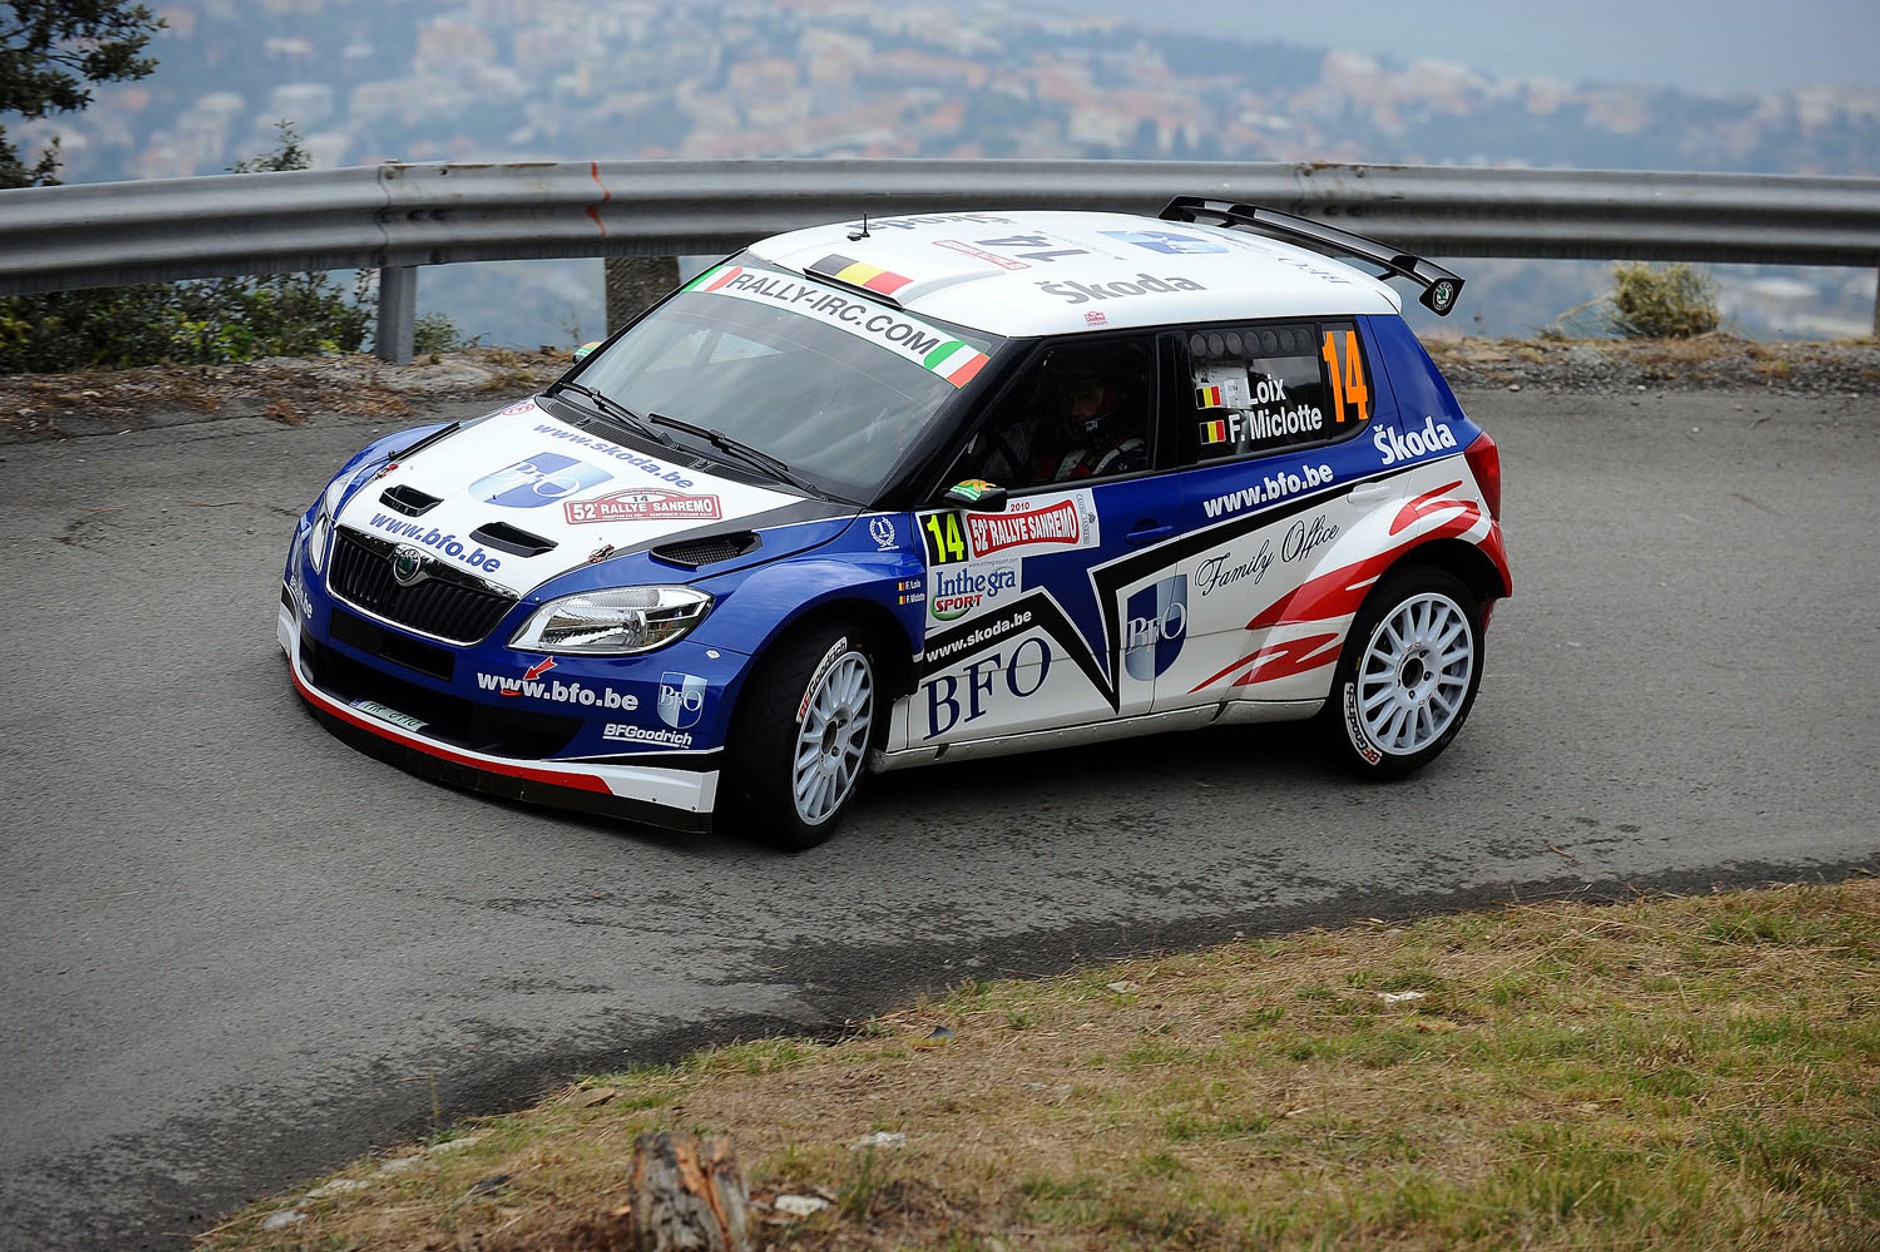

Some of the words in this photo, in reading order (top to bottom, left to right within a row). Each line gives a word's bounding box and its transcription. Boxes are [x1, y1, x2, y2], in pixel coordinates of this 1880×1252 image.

[1034, 273, 1207, 304] Škoda
[726, 273, 941, 355] RALLY-IRC.COM
[1322, 330, 1369, 422] 14
[1228, 413, 1246, 443] F.
[1249, 404, 1323, 440] Miclotte
[1373, 416, 1457, 465] Škoda
[533, 423, 695, 489] www.skoda.be
[601, 502, 648, 515] RALLYE
[653, 500, 713, 513] SANREMO
[1010, 501, 1031, 512] 2010
[1203, 464, 1334, 518] www.bfo.be
[369, 512, 502, 573] www.bfo.be
[927, 513, 965, 563] 14
[990, 516, 1029, 547] RALLYE
[1028, 505, 1077, 540] SANREMO
[1195, 538, 1274, 596] Family
[1281, 514, 1340, 564] Office
[935, 593, 983, 612] SPORT
[936, 566, 1016, 598] Inthegra
[926, 609, 1032, 662] www.skoda.be
[476, 671, 639, 711] www.bfo.be
[660, 685, 702, 711] BFO
[921, 636, 1052, 741] BFO
[604, 723, 693, 746] BFGoodrich
